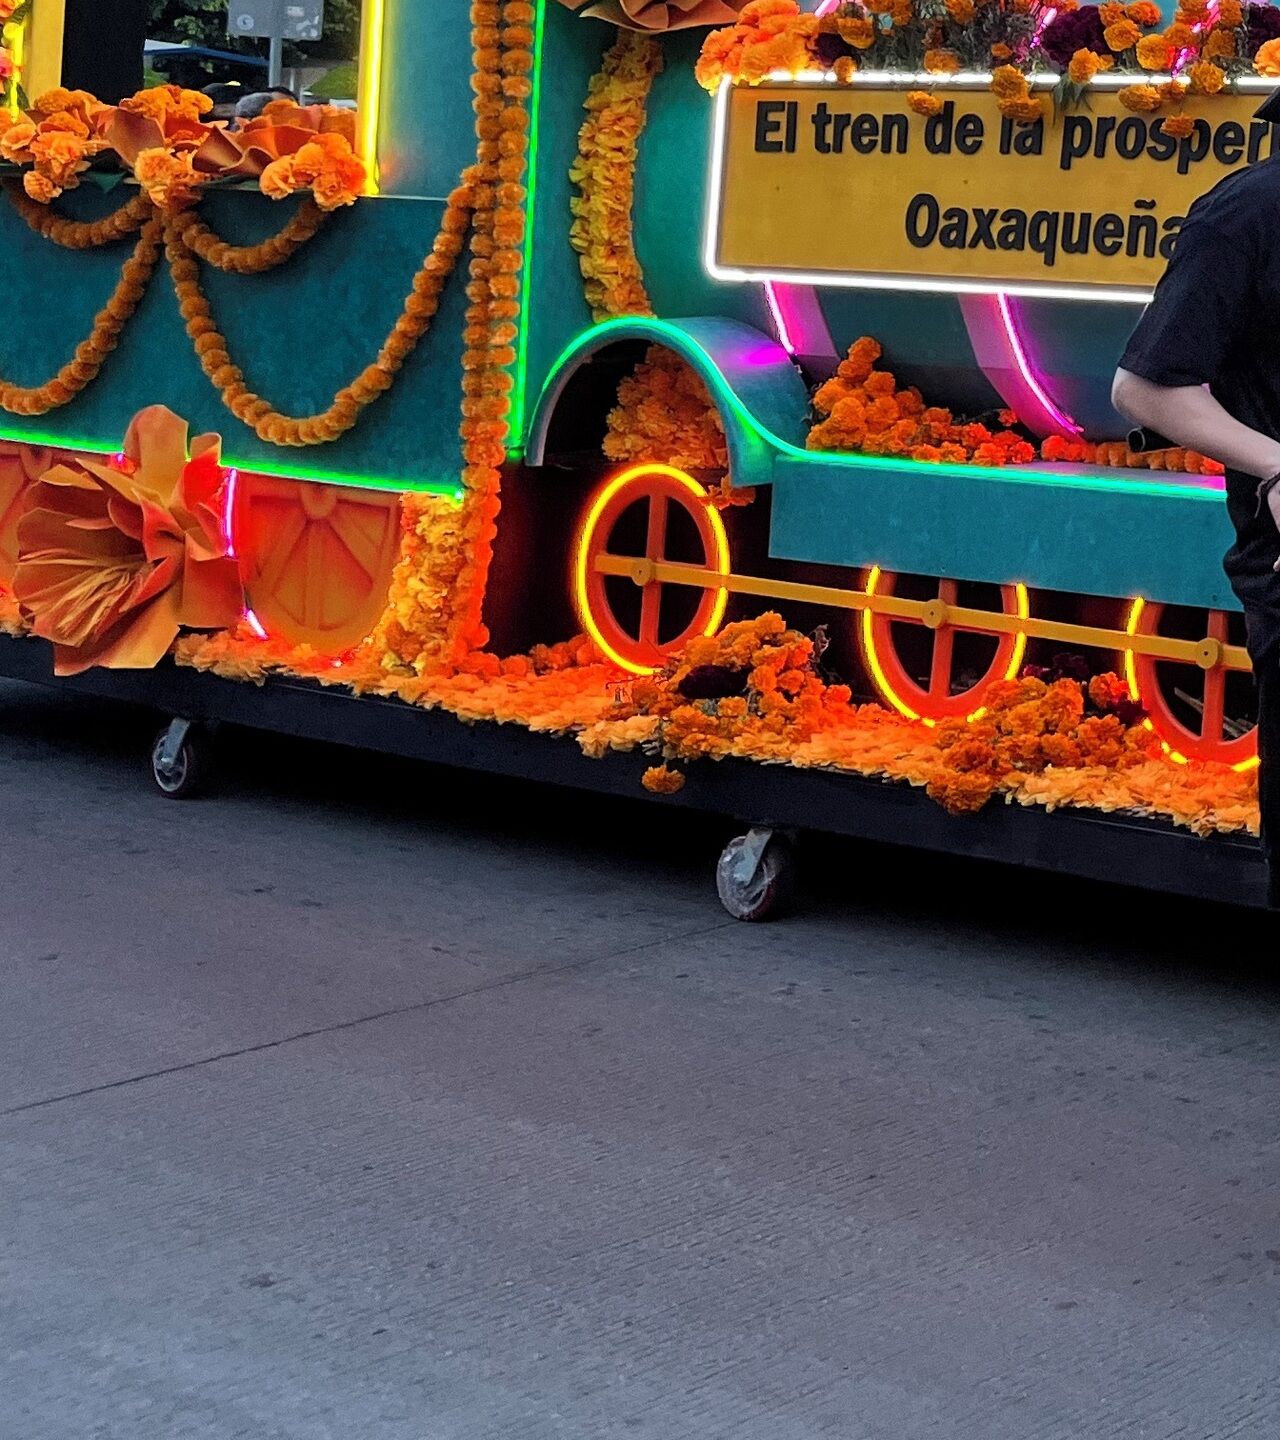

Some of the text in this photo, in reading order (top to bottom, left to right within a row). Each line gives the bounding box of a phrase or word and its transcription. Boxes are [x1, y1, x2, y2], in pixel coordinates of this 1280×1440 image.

[754, 100, 798, 153] El
[811, 102, 909, 153] tren
[924, 100, 984, 155] de
